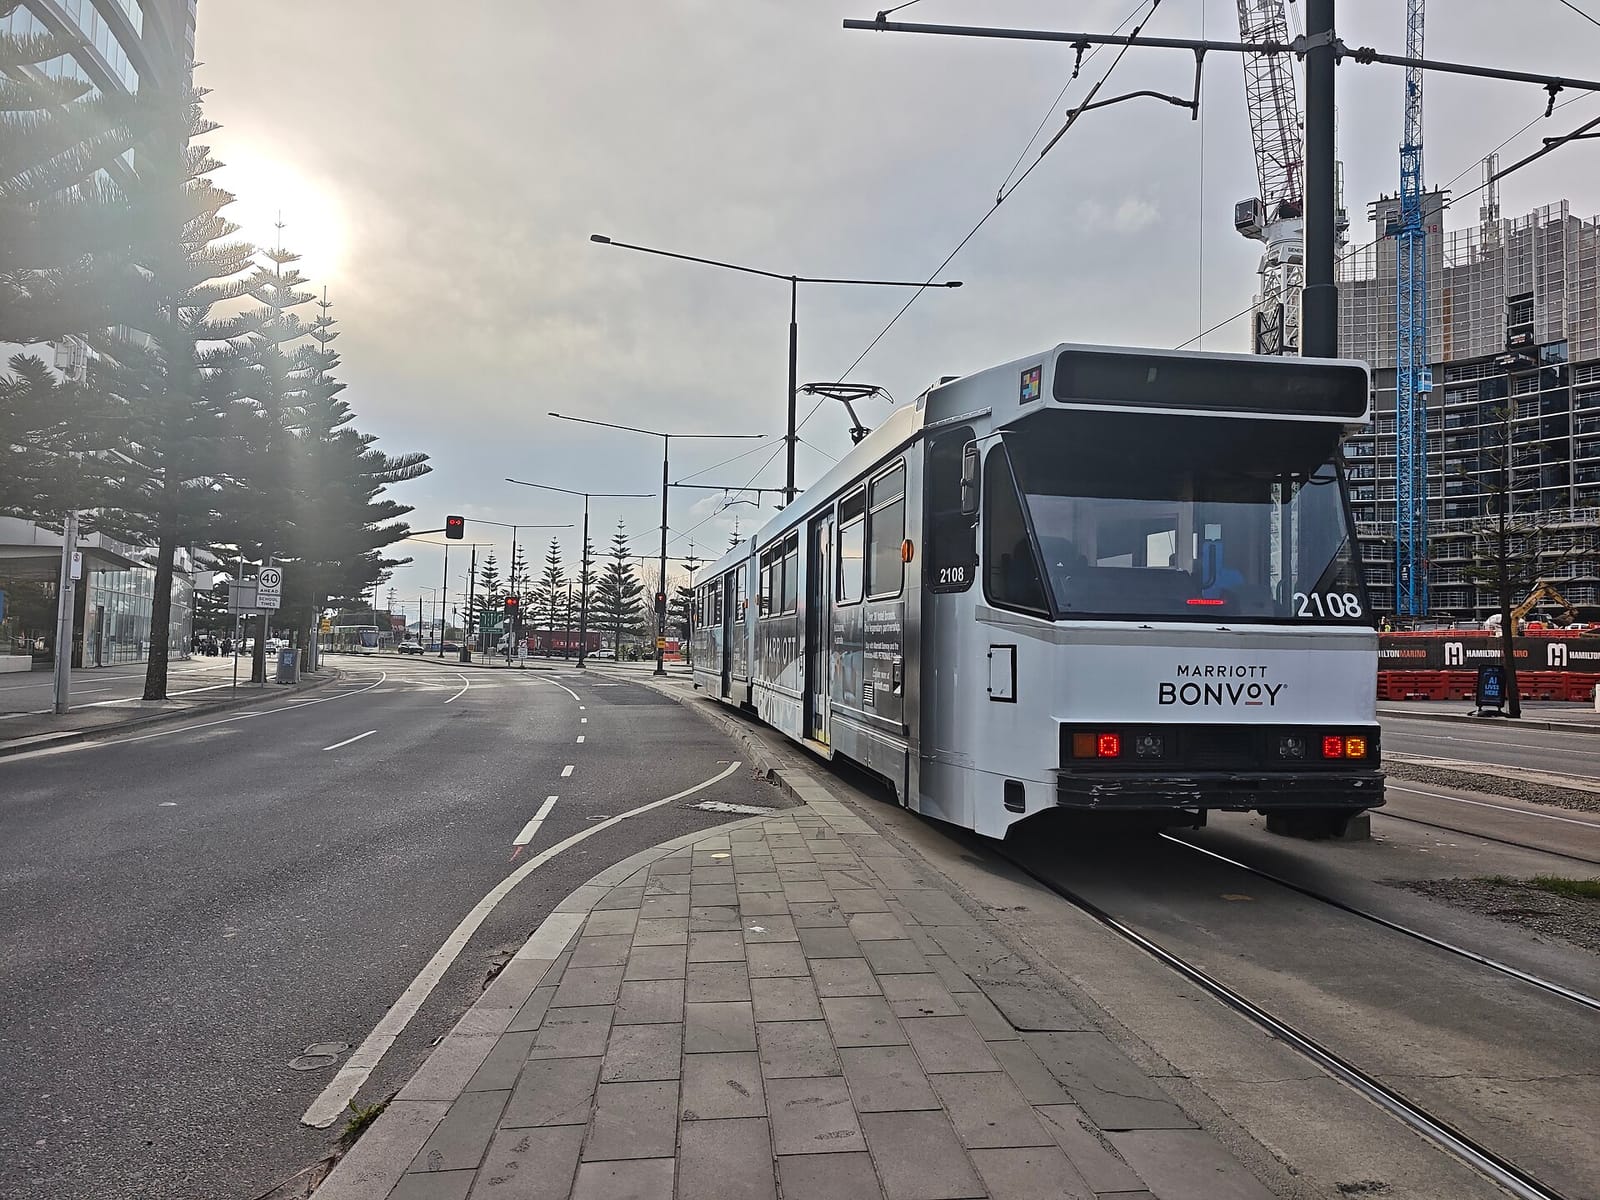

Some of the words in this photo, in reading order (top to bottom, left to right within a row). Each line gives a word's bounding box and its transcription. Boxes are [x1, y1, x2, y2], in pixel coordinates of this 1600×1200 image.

[262, 573, 278, 584] 40
[940, 566, 964, 583] 2108
[1293, 592, 1362, 618] 2108
[764, 637, 796, 665] MARRIOTT
[1177, 665, 1268, 678] MARRIOTT
